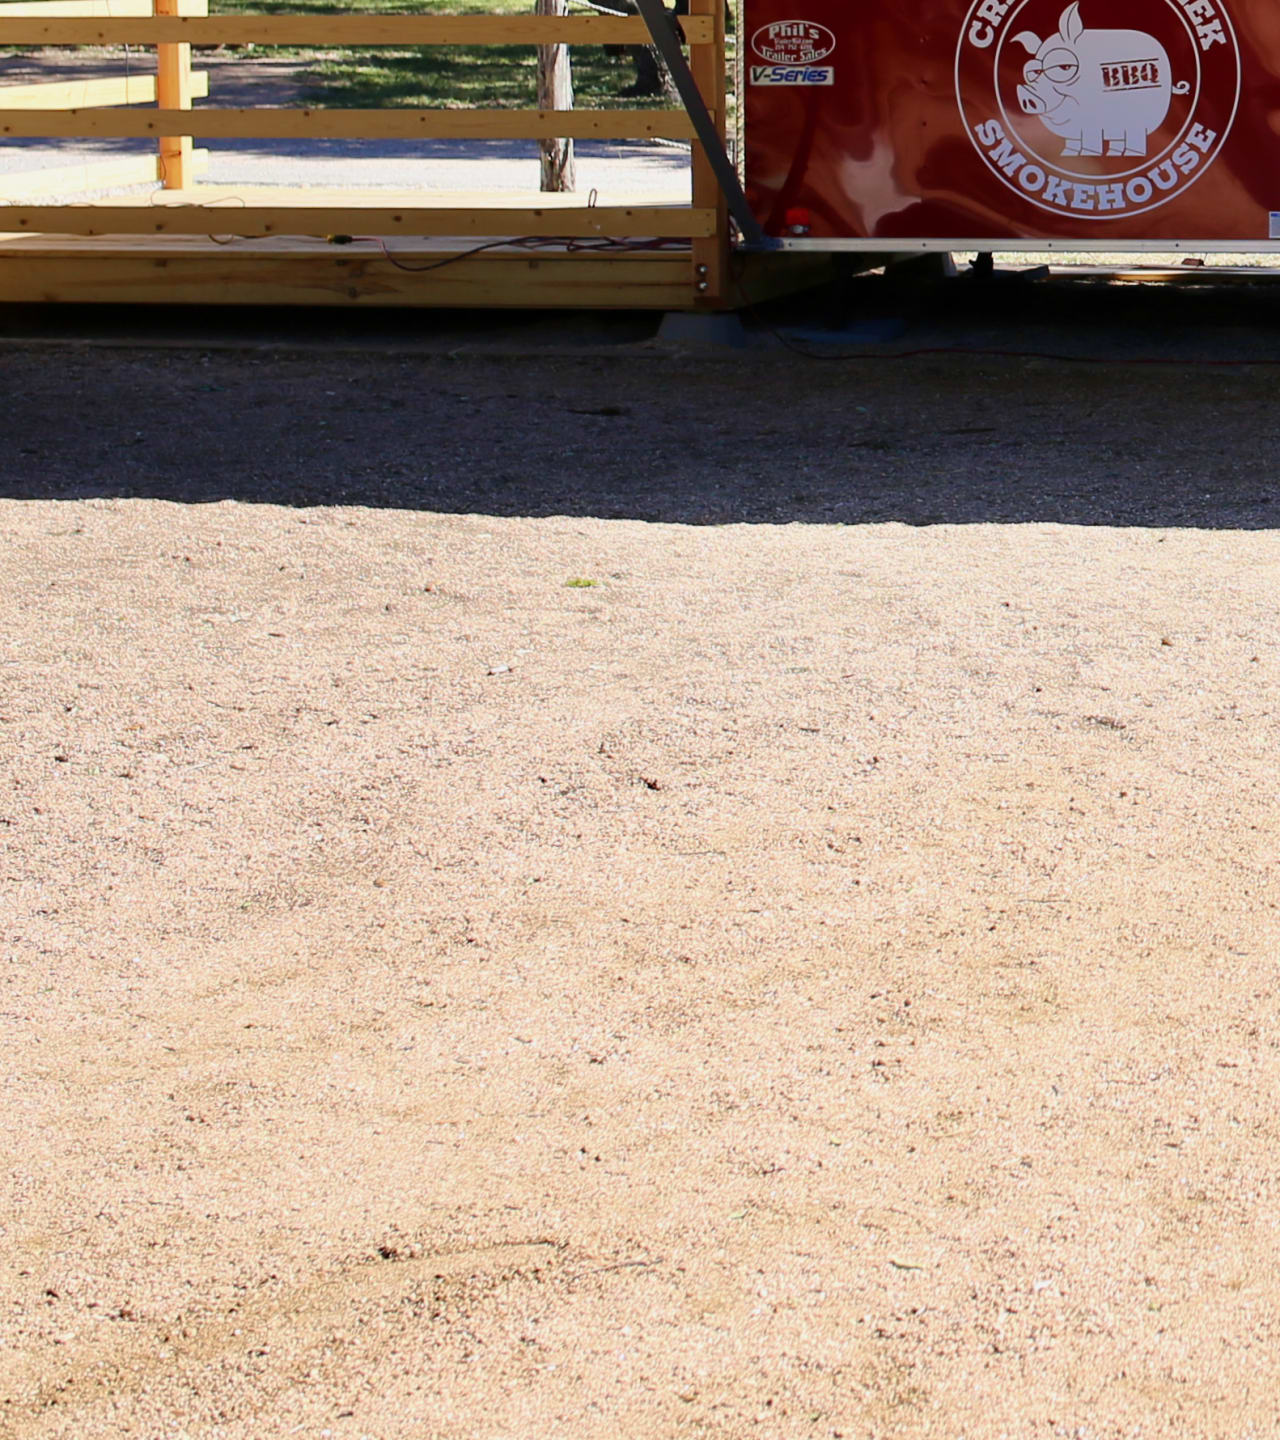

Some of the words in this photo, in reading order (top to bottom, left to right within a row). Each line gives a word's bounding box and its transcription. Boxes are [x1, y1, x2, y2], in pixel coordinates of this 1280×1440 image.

[769, 23, 820, 40] Phil's
[761, 46, 797, 61] Trailer
[800, 48, 827, 62] Sales
[751, 66, 829, 82] V-Series
[1101, 62, 1160, 88] BBQ
[974, 118, 1217, 210] SMOKEHOUSE
